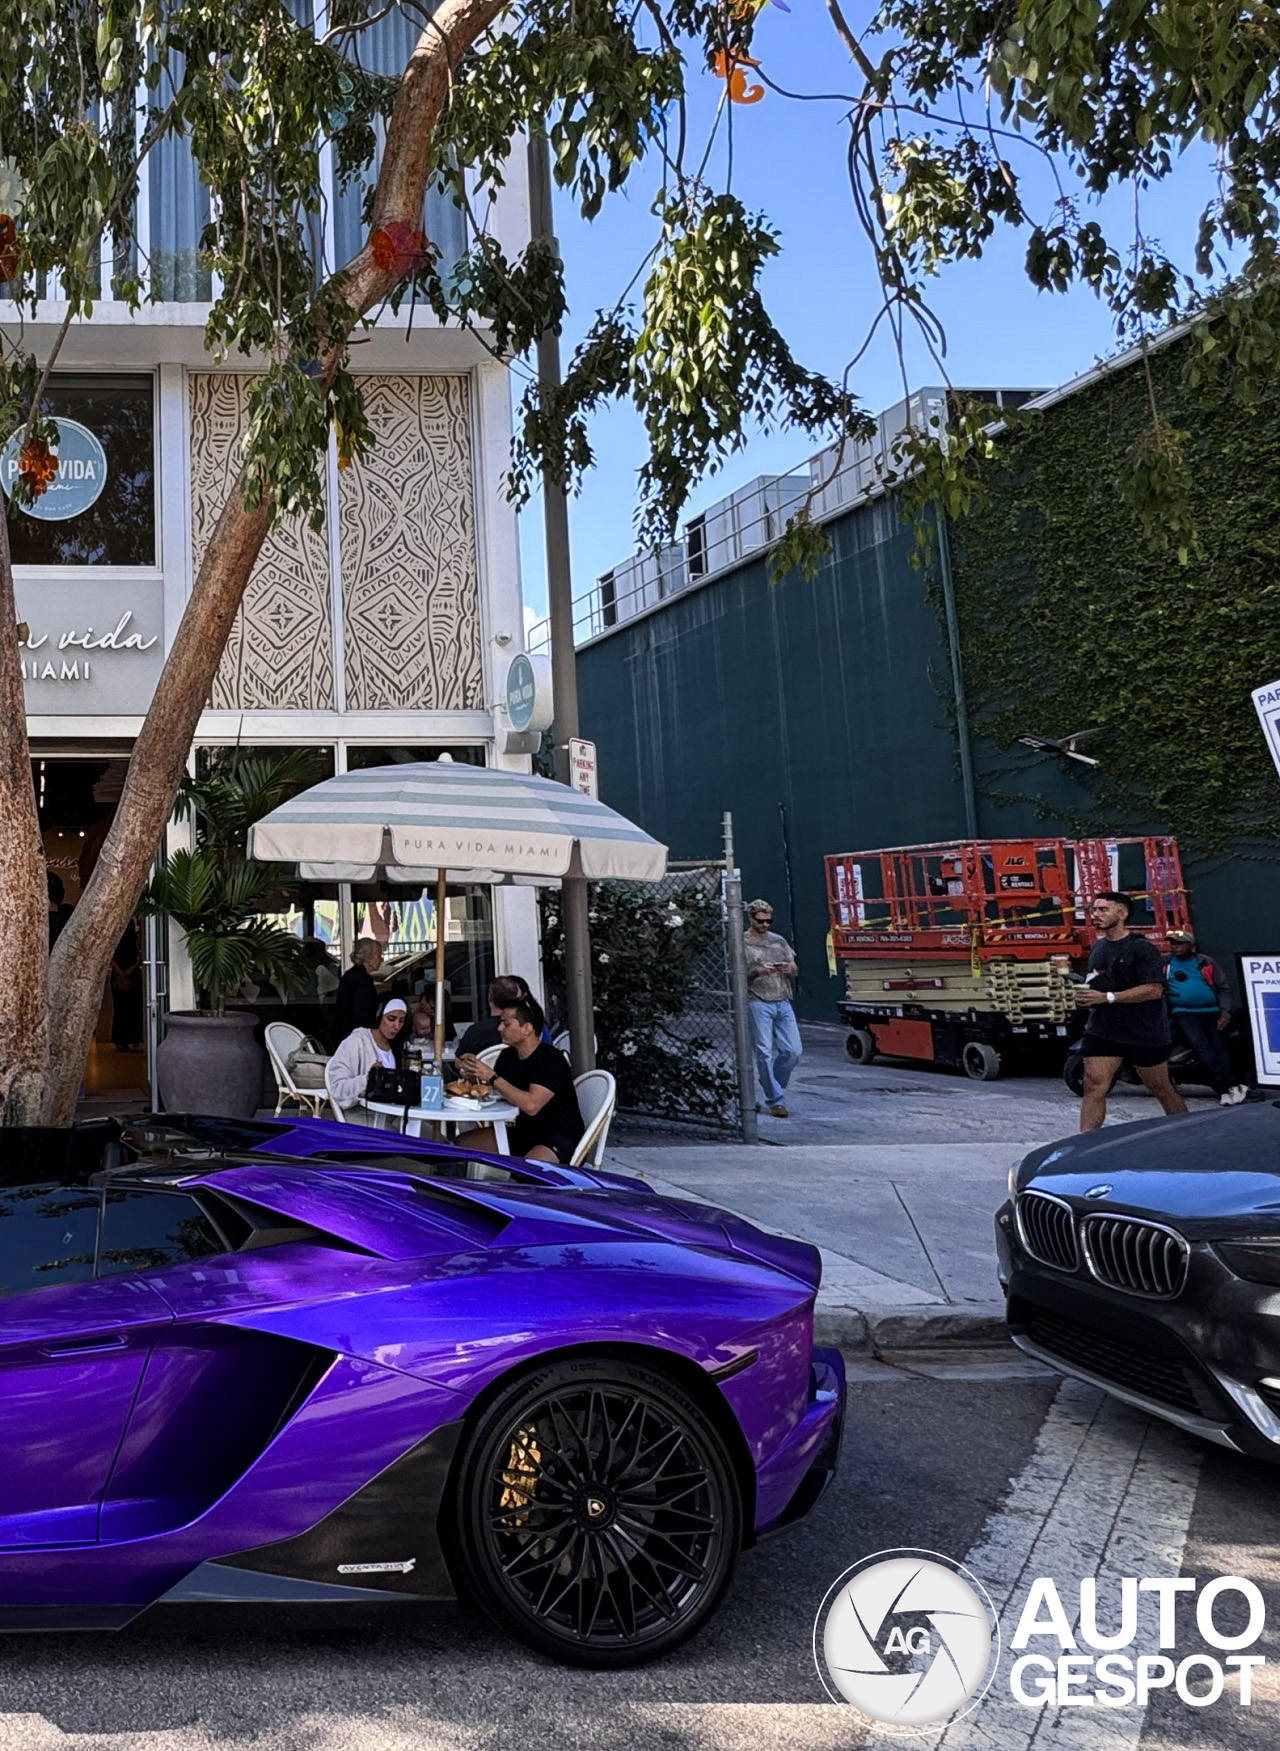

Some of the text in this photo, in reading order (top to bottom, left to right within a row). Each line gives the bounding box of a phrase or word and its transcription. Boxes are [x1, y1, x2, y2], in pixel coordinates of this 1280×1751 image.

[8, 459, 96, 480] PUA VIDA
[58, 611, 158, 650] vida
[573, 757, 594, 771] PARKING
[579, 772, 589, 782] ANY
[404, 839, 558, 858] PURA VIDA MIAMI
[1005, 857, 1024, 866] JLG
[422, 1085, 440, 1103] 27
